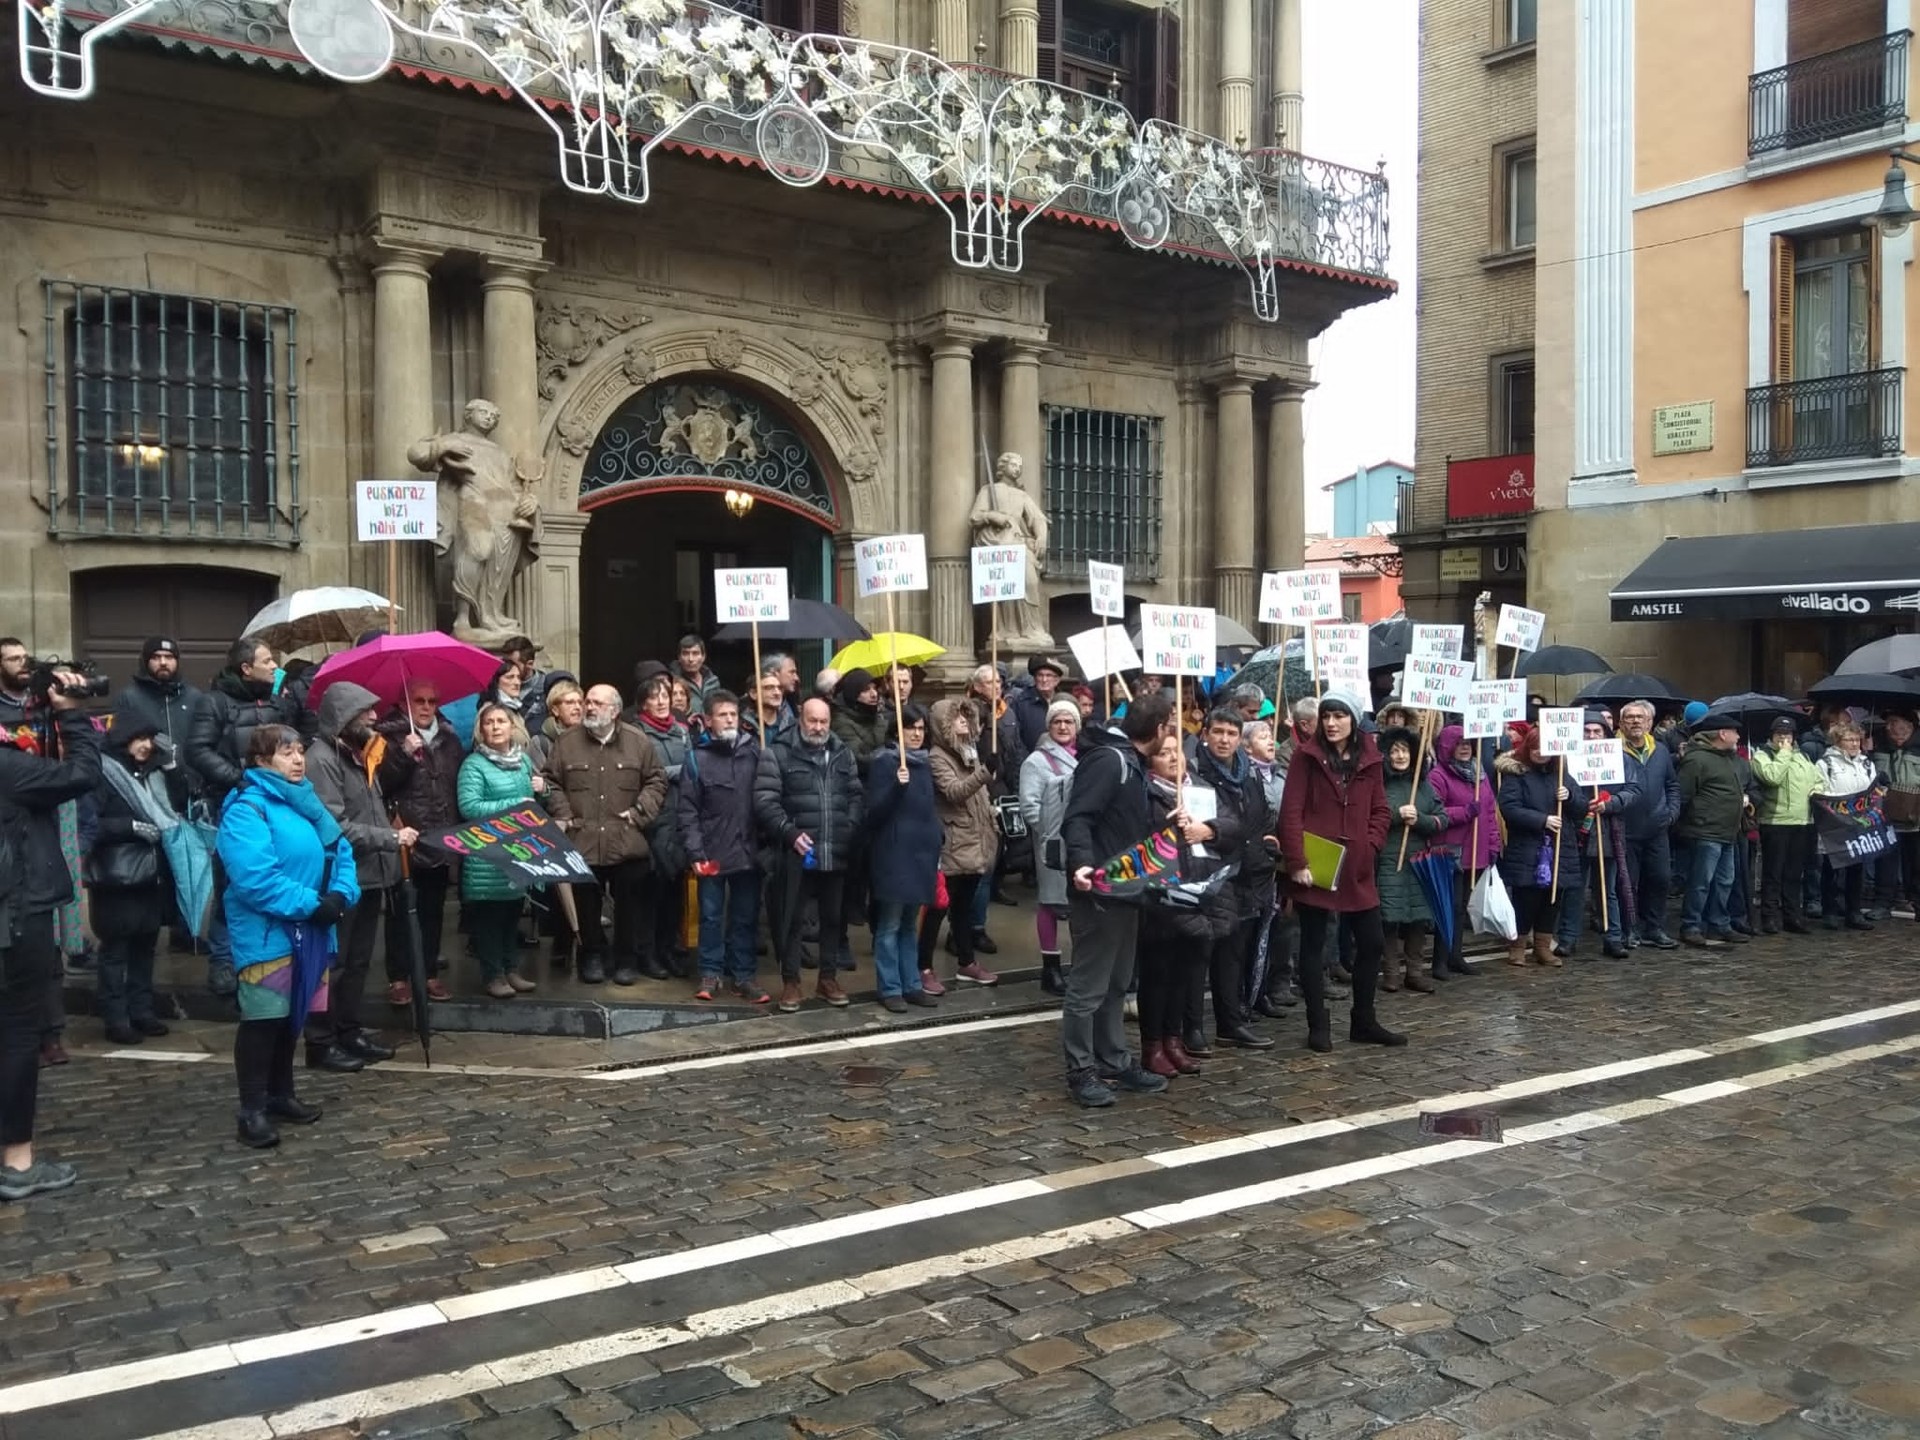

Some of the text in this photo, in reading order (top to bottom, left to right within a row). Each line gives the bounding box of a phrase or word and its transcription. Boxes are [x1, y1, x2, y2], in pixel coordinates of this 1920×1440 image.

[366, 486, 426, 501] euskaraz
[383, 503, 408, 518] bizi
[369, 520, 425, 535] nahi dut
[1631, 603, 1683, 615] AMSTEL
[1152, 611, 1208, 629] euskaraz
[1170, 632, 1192, 648] bizi
[1156, 652, 1205, 669] nahi dut
[1413, 659, 1464, 677] euskaraz
[1424, 676, 1445, 691] bizi
[1410, 690, 1456, 707] nahi dut
[443, 809, 548, 855] euskaraz
[502, 833, 556, 862] bizi
[1845, 830, 1884, 858] nahi
